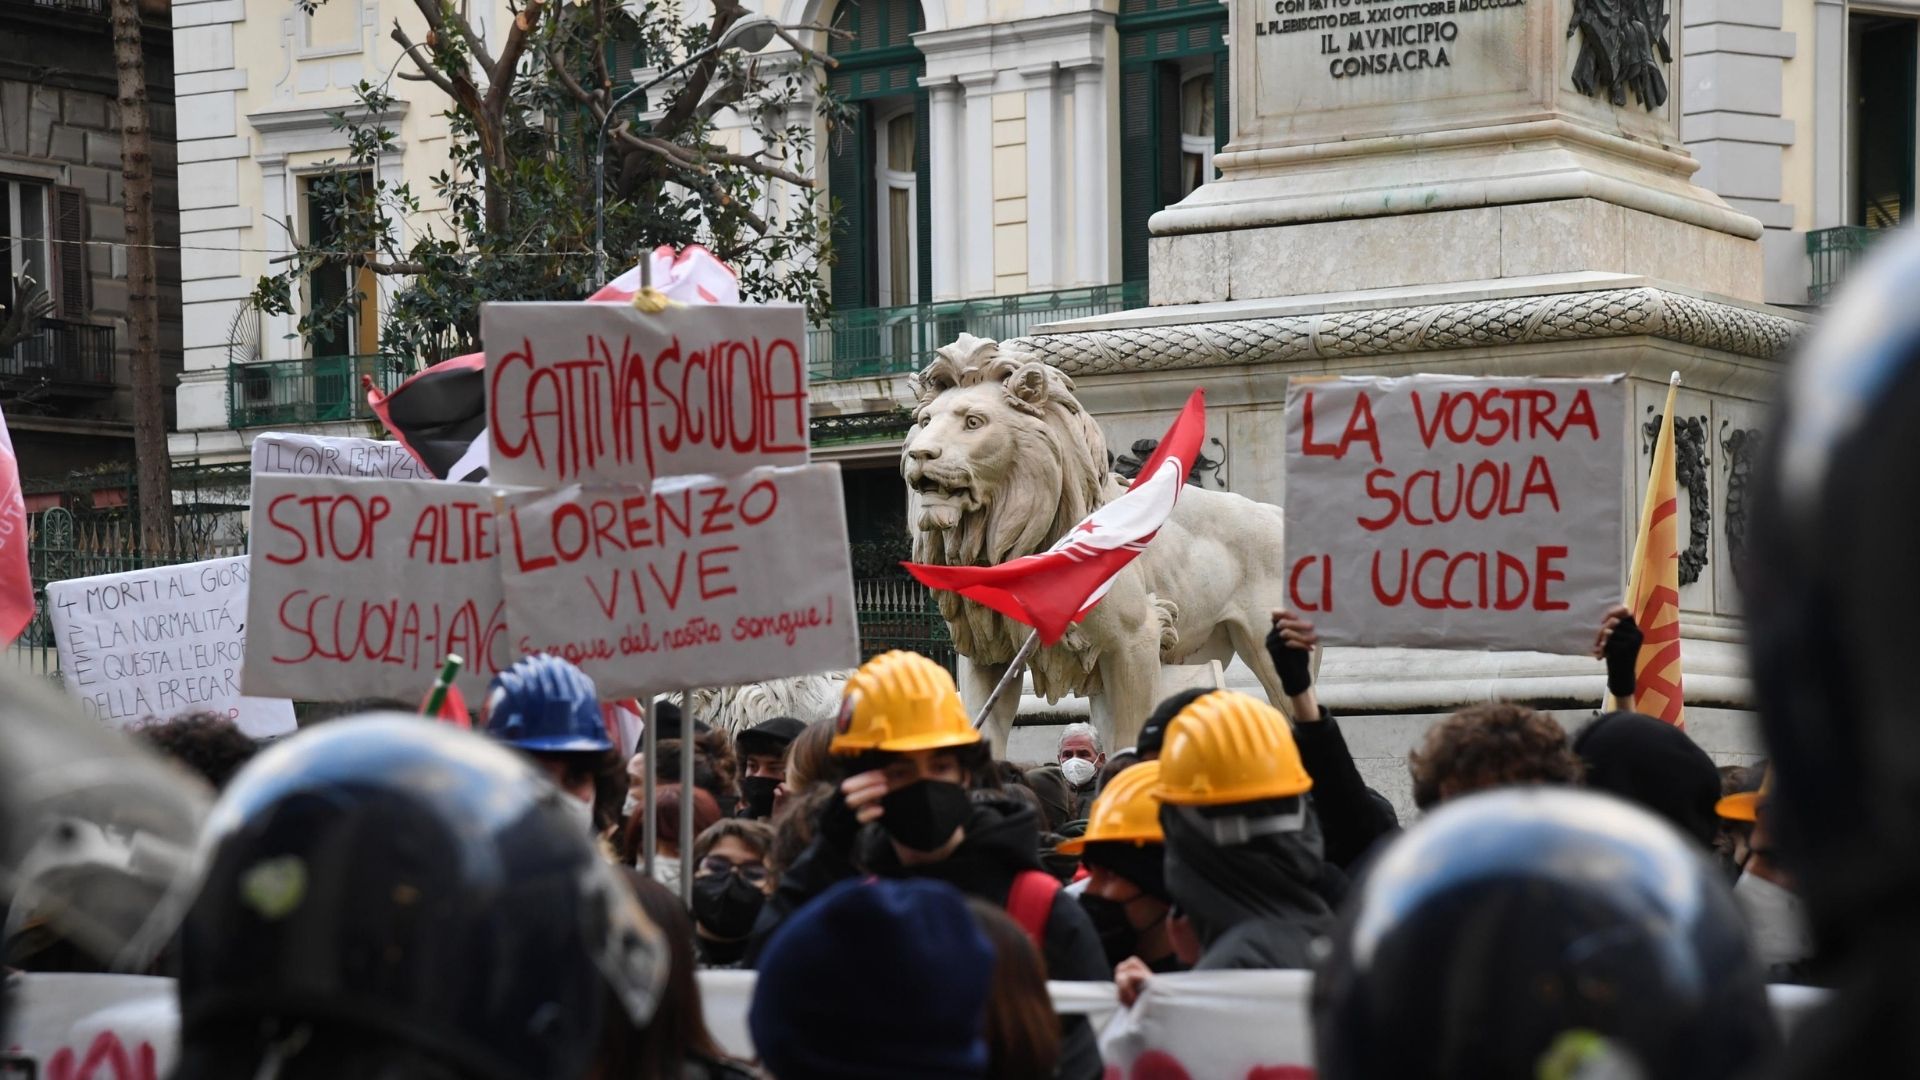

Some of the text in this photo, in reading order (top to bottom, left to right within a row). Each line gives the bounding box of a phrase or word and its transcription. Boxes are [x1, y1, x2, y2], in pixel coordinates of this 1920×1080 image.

[1256, 23, 1266, 36] IL
[1269, 15, 1337, 34] PLEBISCITO
[1340, 11, 1364, 27] DEL
[1367, 7, 1390, 24] XXI
[1393, 1, 1455, 20] OTTOBRE
[1275, 0, 1304, 14] CON
[1321, 21, 1458, 54] IL MVNICIPIO
[1330, 48, 1450, 78] CONSACRA
[1301, 387, 1599, 463] LA VOSTRA
[1357, 455, 1560, 531] SCUOLA
[265, 494, 500, 564] STOP ALTE
[509, 480, 778, 573] LORENZO
[57, 593, 78, 618] 4
[87, 579, 159, 614] MORTI
[169, 574, 196, 598] AL
[585, 545, 739, 620] VIVE
[1289, 545, 1570, 612] CI UCCIDE
[96, 622, 128, 649] LA
[619, 622, 658, 657] del
[662, 616, 722, 651] nostro
[103, 651, 173, 680] QUESTA
[83, 688, 152, 722] DELLA
